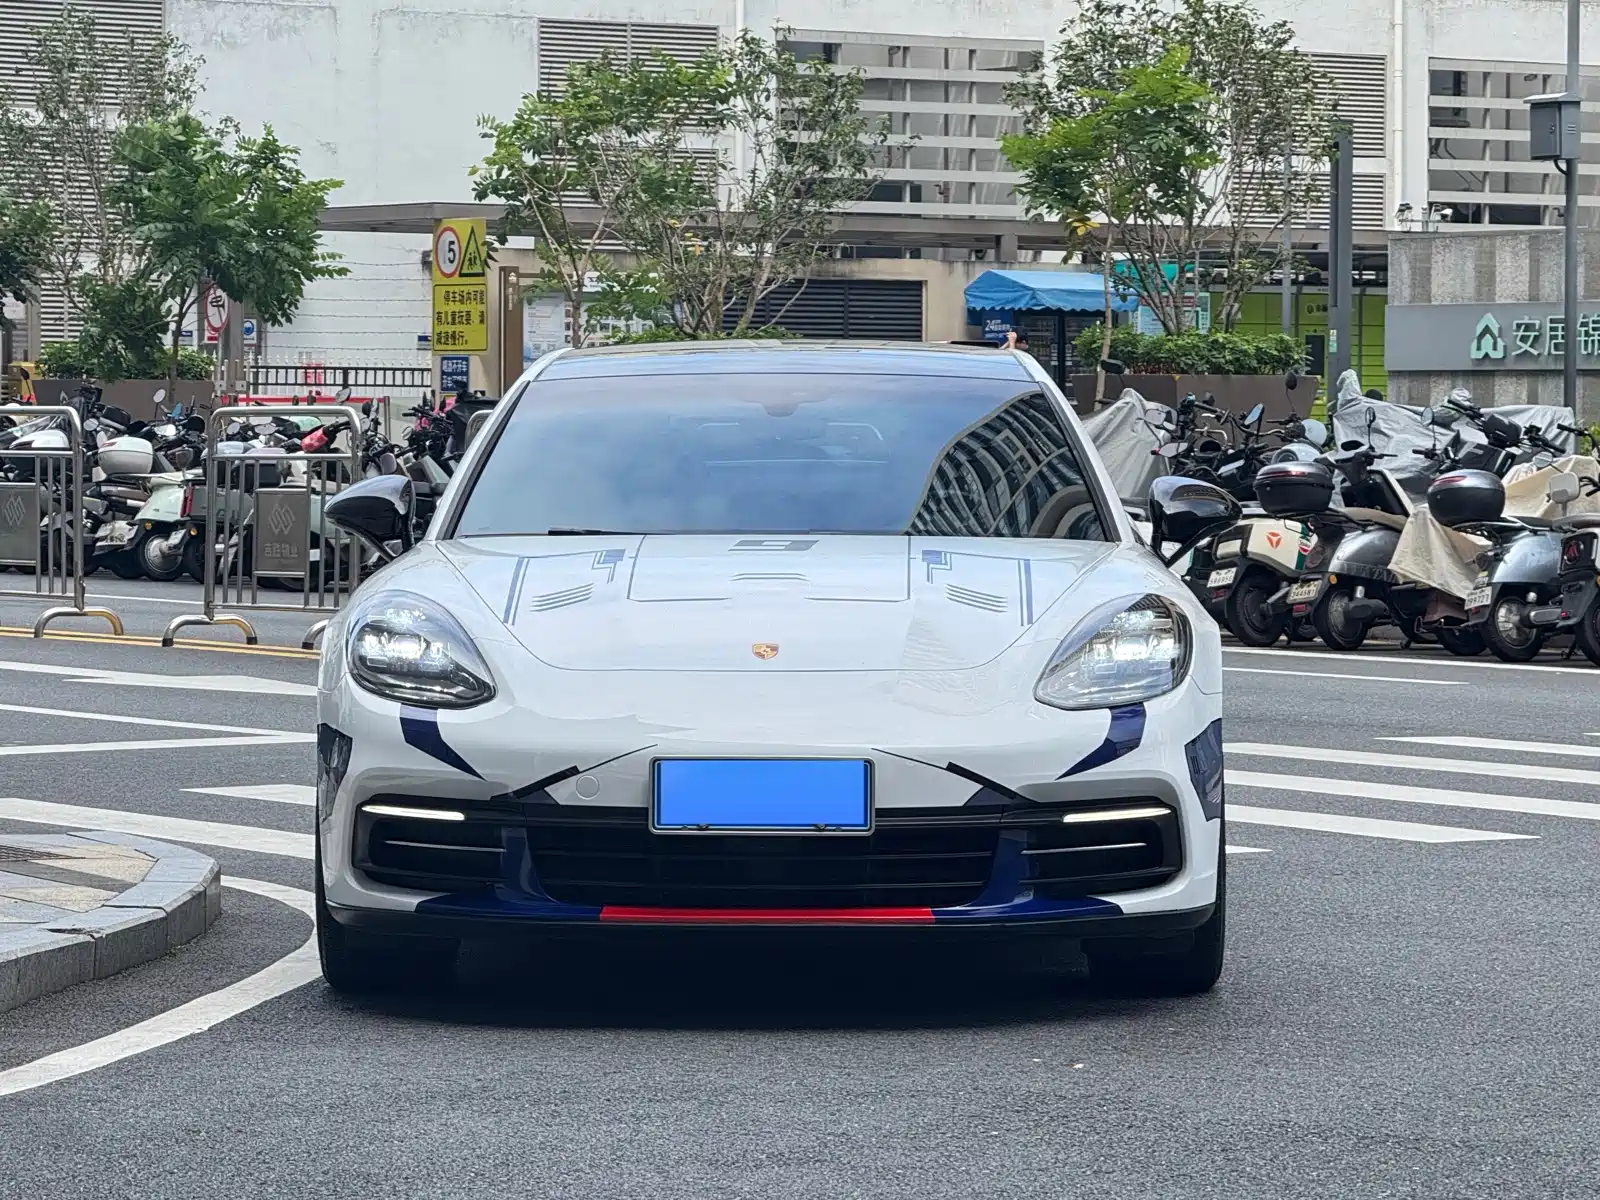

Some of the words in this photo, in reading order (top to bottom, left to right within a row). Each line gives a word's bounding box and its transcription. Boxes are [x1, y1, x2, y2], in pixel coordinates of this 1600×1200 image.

[443, 289, 485, 305] 停车场内可能
